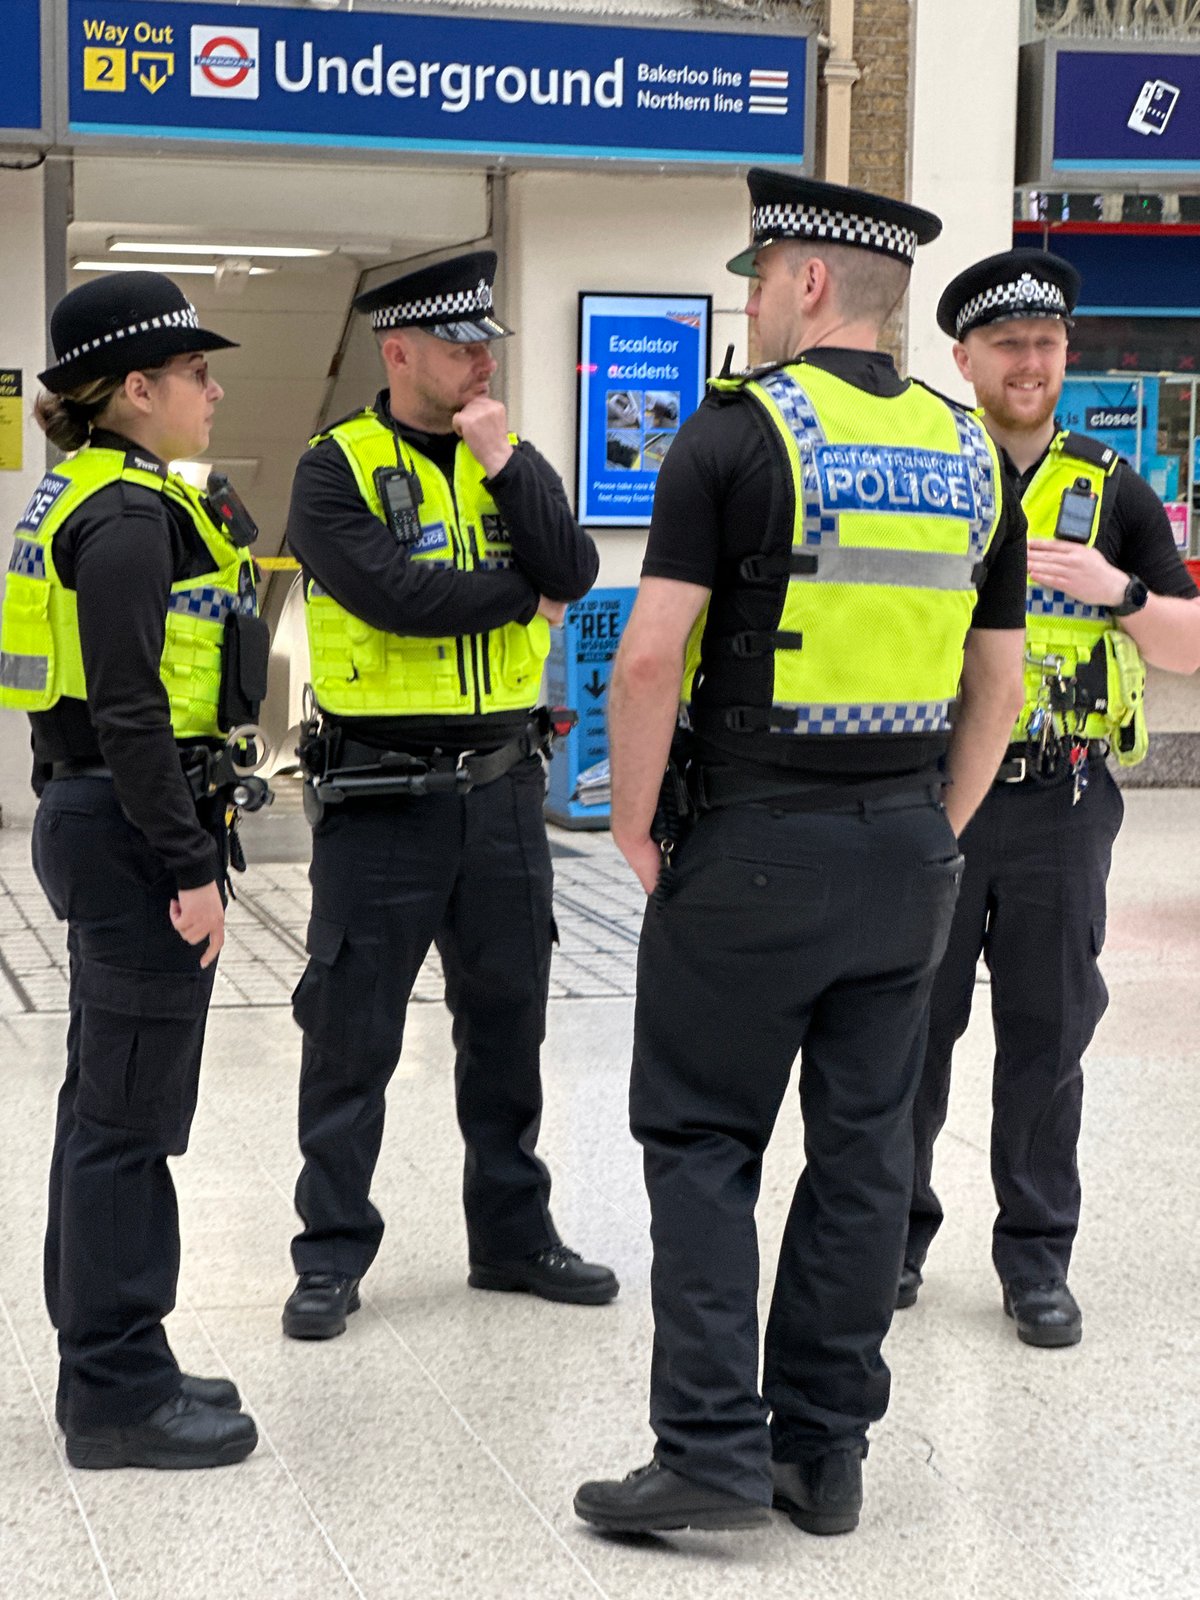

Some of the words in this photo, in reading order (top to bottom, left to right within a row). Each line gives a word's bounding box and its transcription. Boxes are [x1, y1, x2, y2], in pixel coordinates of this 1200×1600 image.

[83, 19, 129, 46] Way
[134, 22, 174, 45] Out
[95, 55, 114, 82] 2
[275, 40, 624, 112] Underground
[637, 63, 709, 86] Bakerloo
[712, 66, 742, 88] line
[637, 89, 711, 111] Northern
[713, 92, 744, 114] line
[609, 335, 679, 354] Escalator
[607, 361, 679, 380] accidents
[823, 451, 881, 467] BRITISH
[886, 454, 963, 474] TRANSPORT
[825, 468, 970, 511] POLICE
[414, 531, 445, 548] OLICE
[569, 611, 620, 639] FREE
